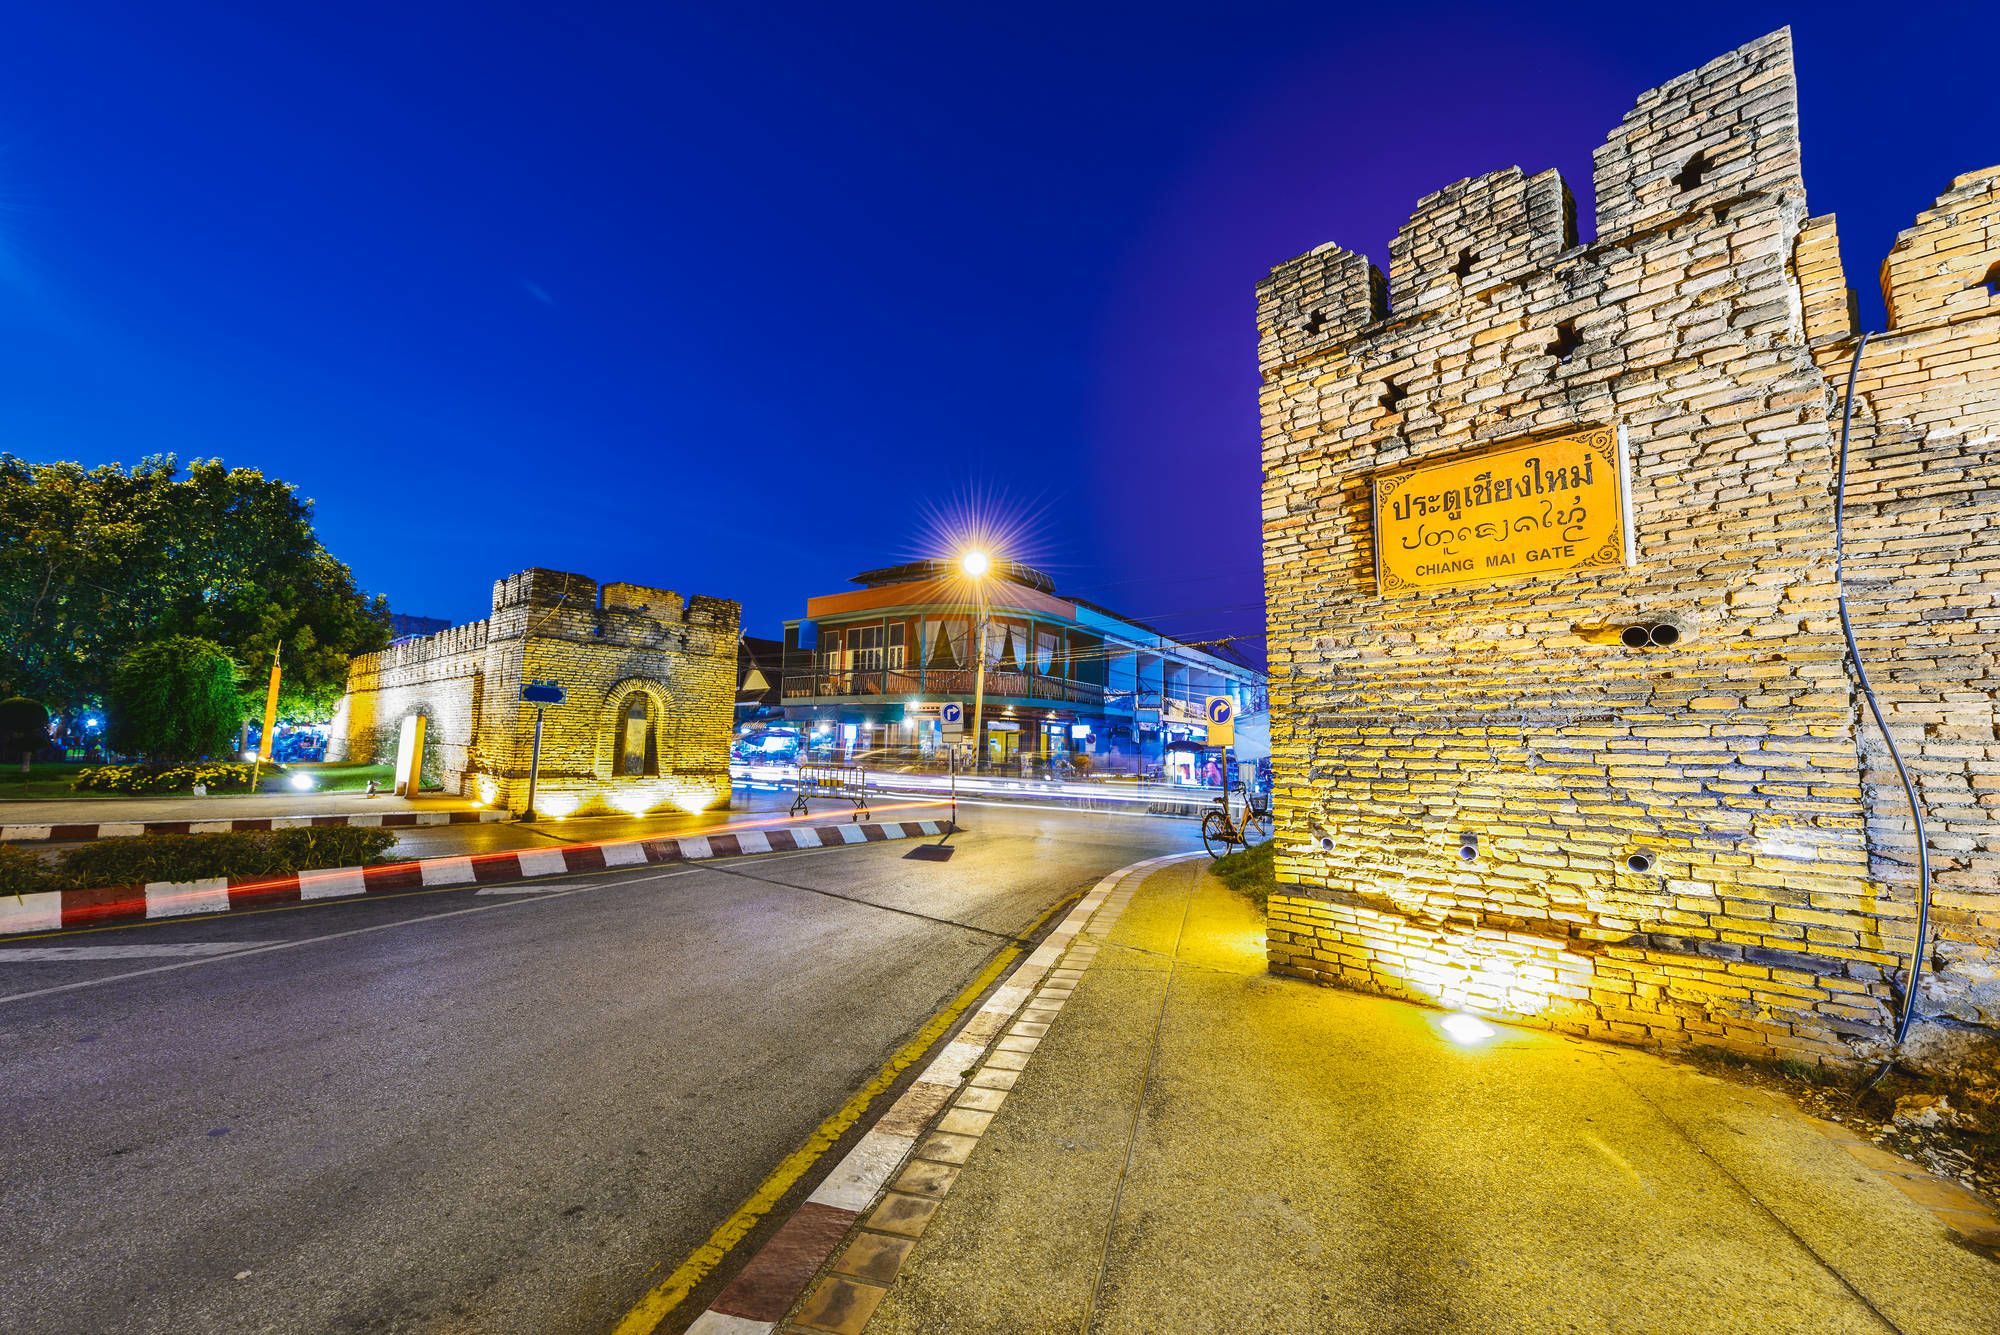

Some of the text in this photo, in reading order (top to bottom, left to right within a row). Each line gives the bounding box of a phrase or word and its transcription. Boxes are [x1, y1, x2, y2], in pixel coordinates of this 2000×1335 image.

[1393, 453, 1594, 521] ประตูเชียงใหม่
[1415, 545, 1575, 577] CHIANG MAI GATE
